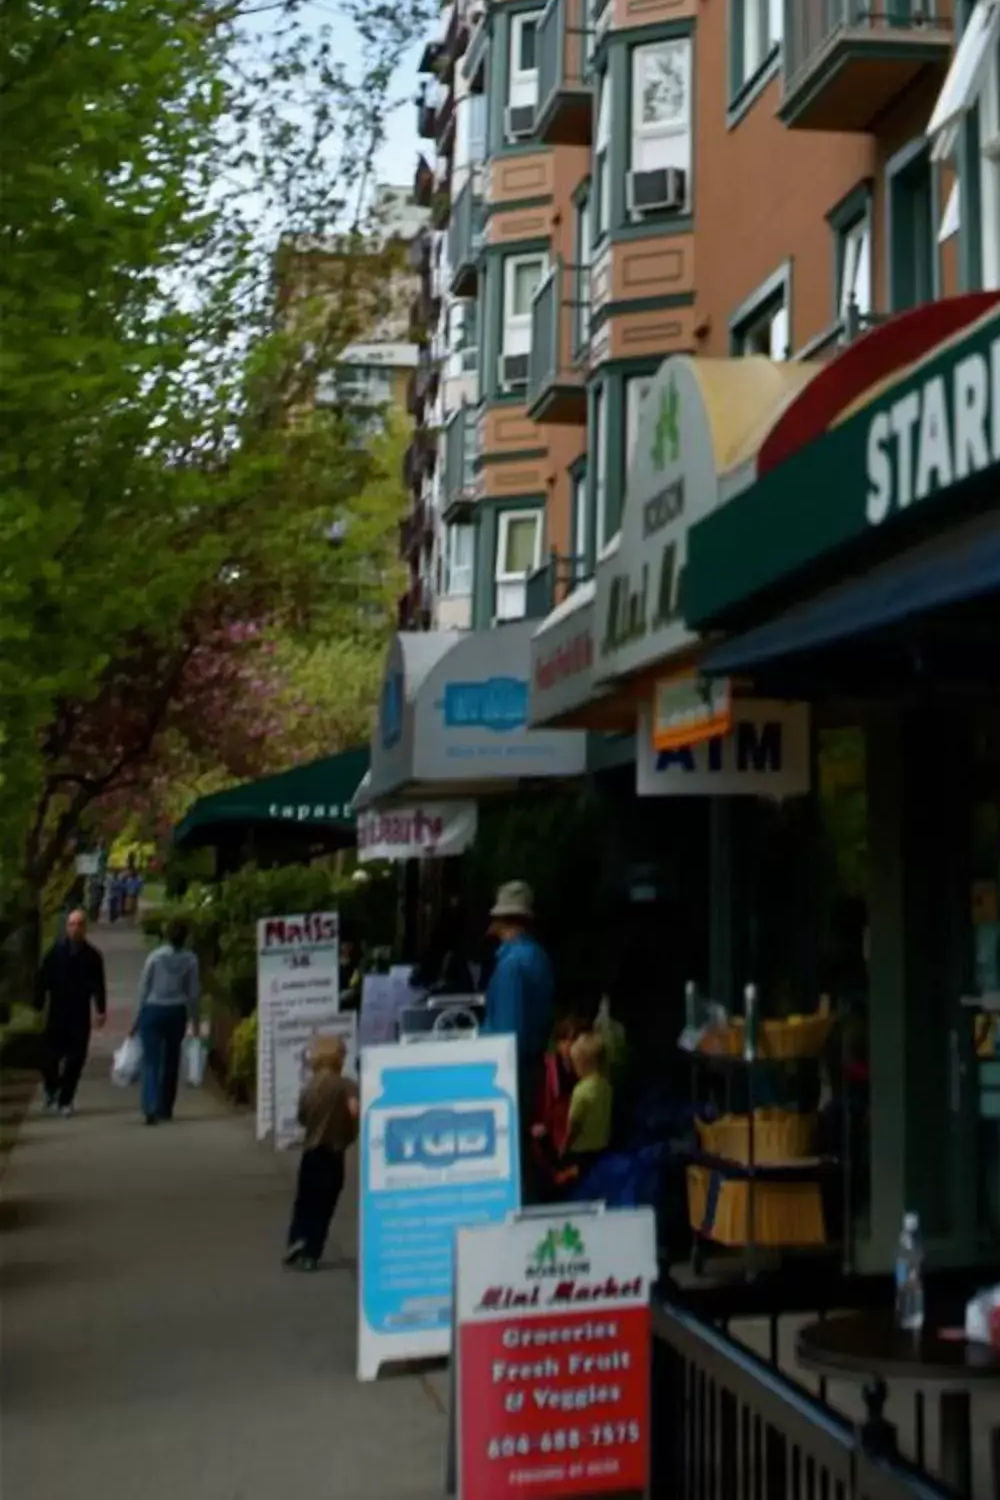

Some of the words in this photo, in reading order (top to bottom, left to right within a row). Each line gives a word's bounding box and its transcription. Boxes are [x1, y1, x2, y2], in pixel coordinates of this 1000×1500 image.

[477, 1284, 540, 1312] Mini
[549, 1273, 642, 1304] Market
[502, 1321, 619, 1348] Groceries
[492, 1355, 560, 1382] Fresh
[568, 1349, 631, 1375] Fruit
[533, 1383, 621, 1412] Veggies
